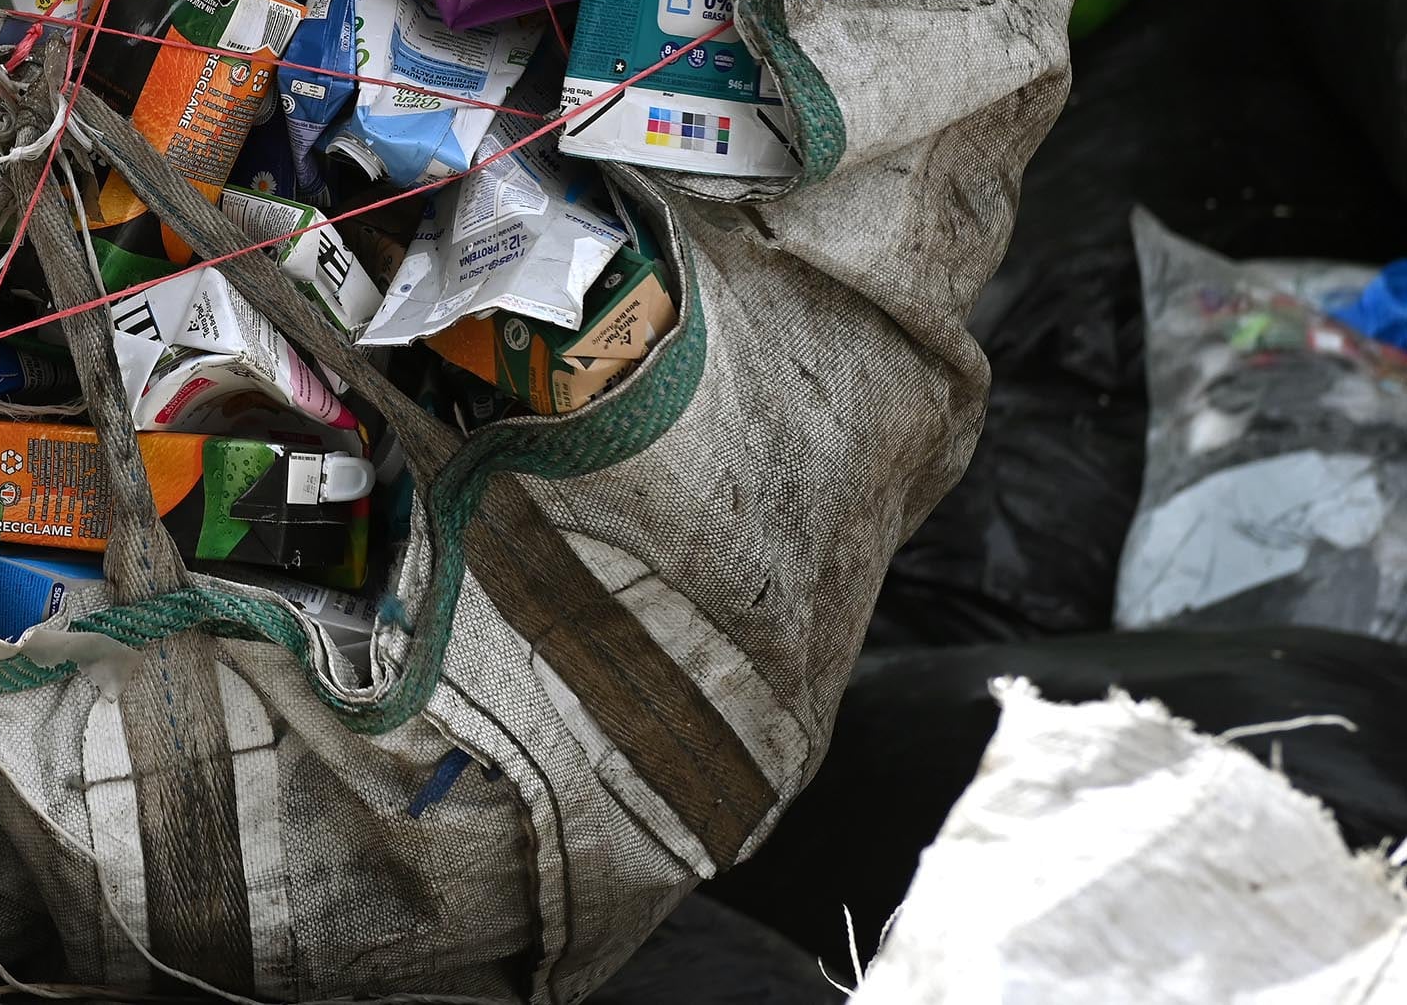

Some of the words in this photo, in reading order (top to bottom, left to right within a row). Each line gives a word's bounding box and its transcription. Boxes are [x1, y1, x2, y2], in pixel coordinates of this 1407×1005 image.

[203, 2, 216, 14] SIN
[702, 9, 726, 22] GRASA
[691, 48, 705, 59] 313
[411, 67, 437, 78] FACTS
[419, 71, 479, 91] INFORMACIÓN
[728, 79, 742, 91] 946
[177, 52, 220, 129] RECICLAME
[393, 101, 420, 109] NÉCTAR
[459, 242, 501, 267] PROTEÍNA
[201, 316, 209, 338] Tetra
[50, 585, 62, 607] 50%
